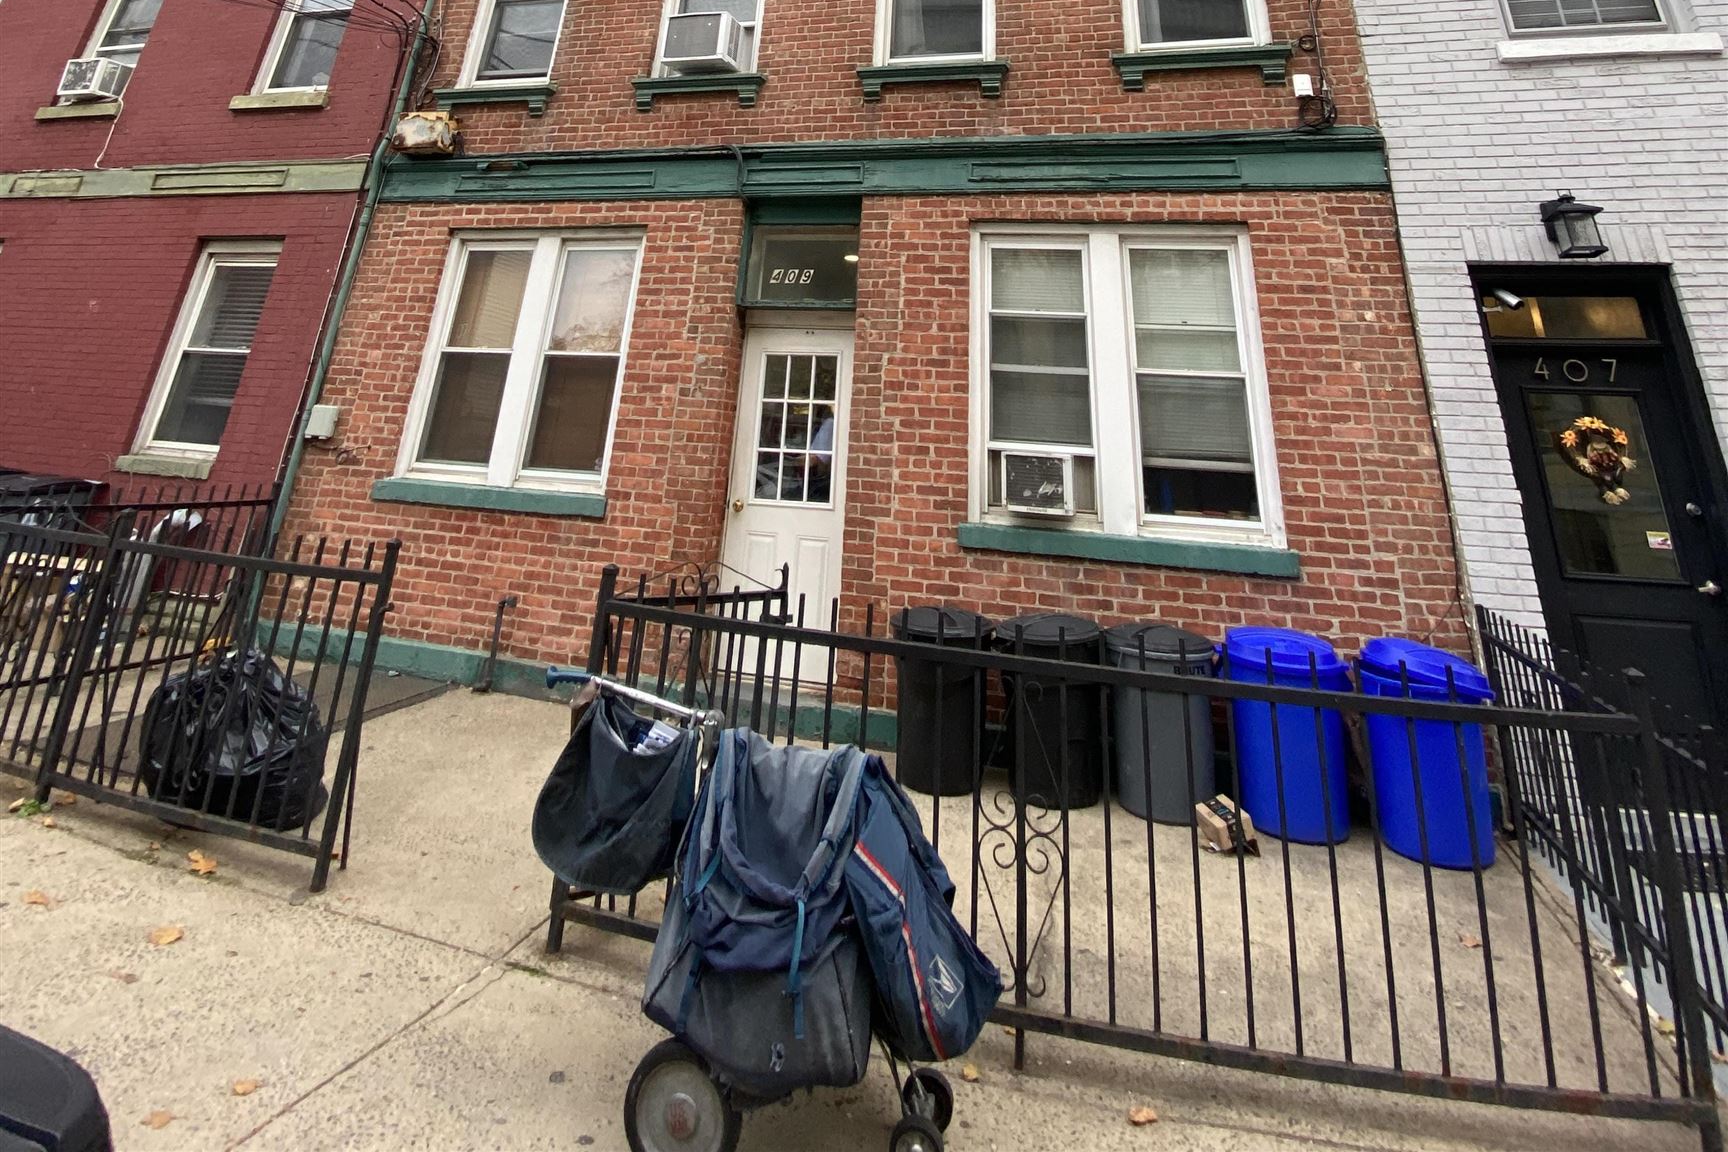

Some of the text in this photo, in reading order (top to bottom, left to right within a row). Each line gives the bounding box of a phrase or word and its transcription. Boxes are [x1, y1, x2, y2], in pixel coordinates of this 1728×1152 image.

[769, 269, 814, 284] 409
[1534, 357, 1617, 382] 407
[1173, 665, 1206, 676] BUTE
